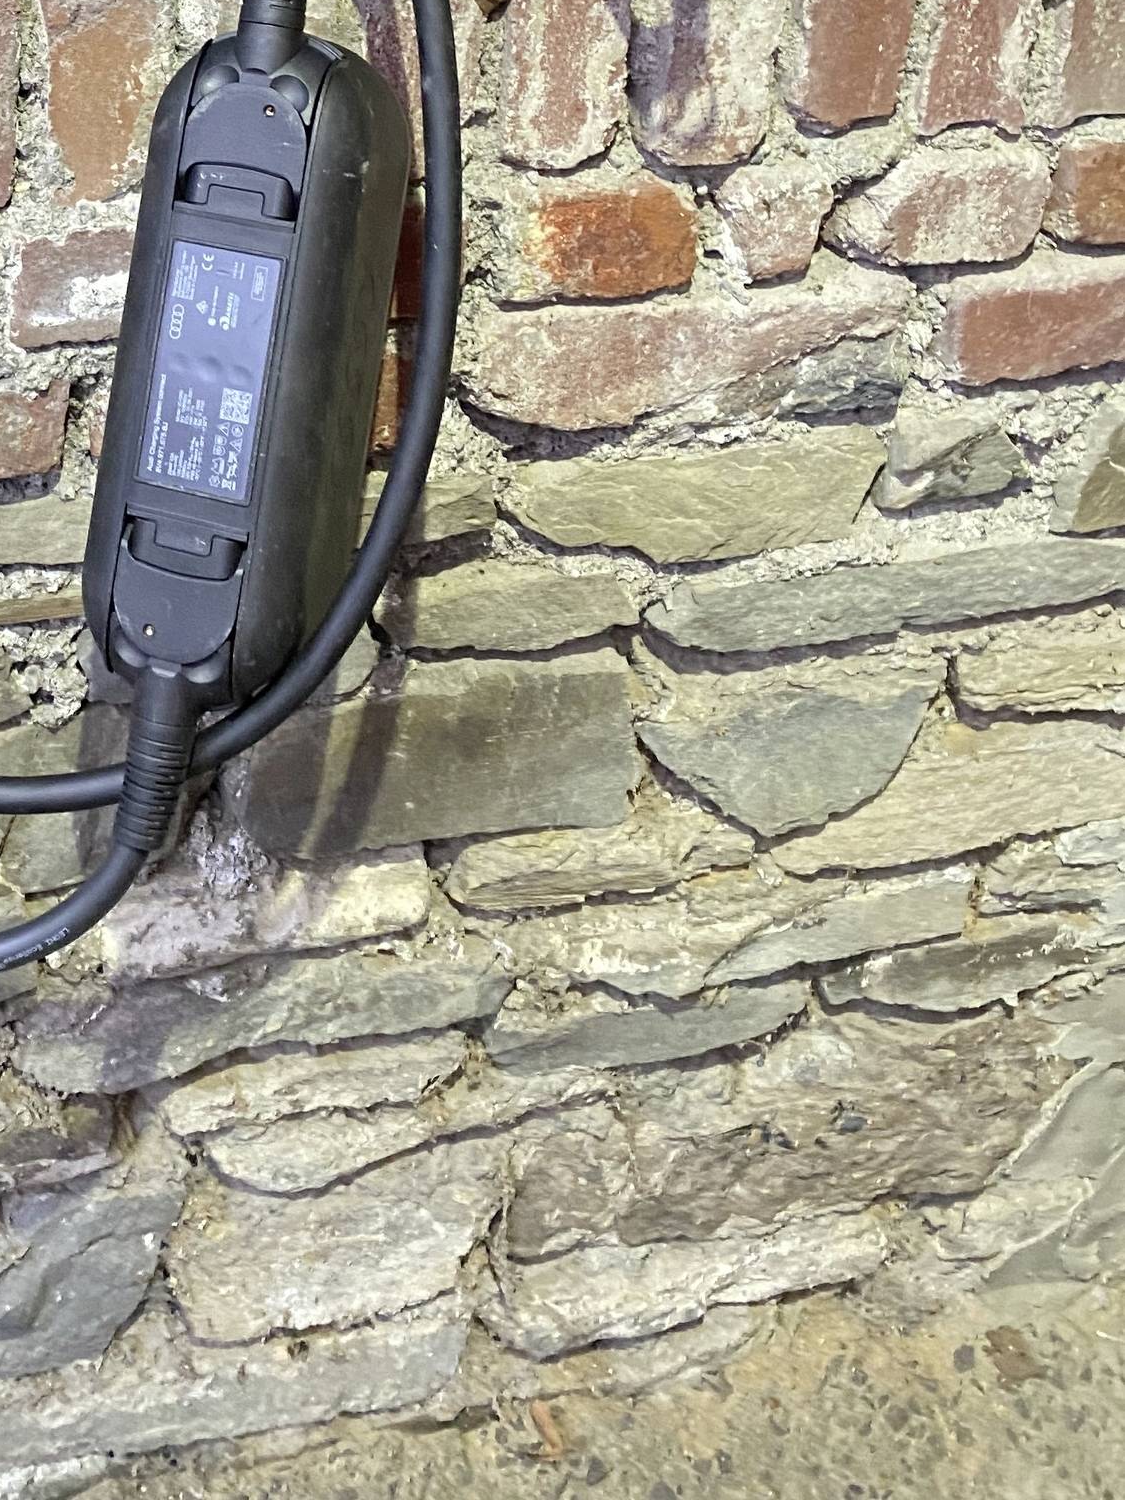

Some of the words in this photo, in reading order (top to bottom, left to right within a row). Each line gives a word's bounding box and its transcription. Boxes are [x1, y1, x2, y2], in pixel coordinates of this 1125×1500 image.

[202, 253, 215, 271] CE
[154, 399, 164, 425] System
[149, 425, 160, 454] Charging
[147, 454, 155, 472] Audi
